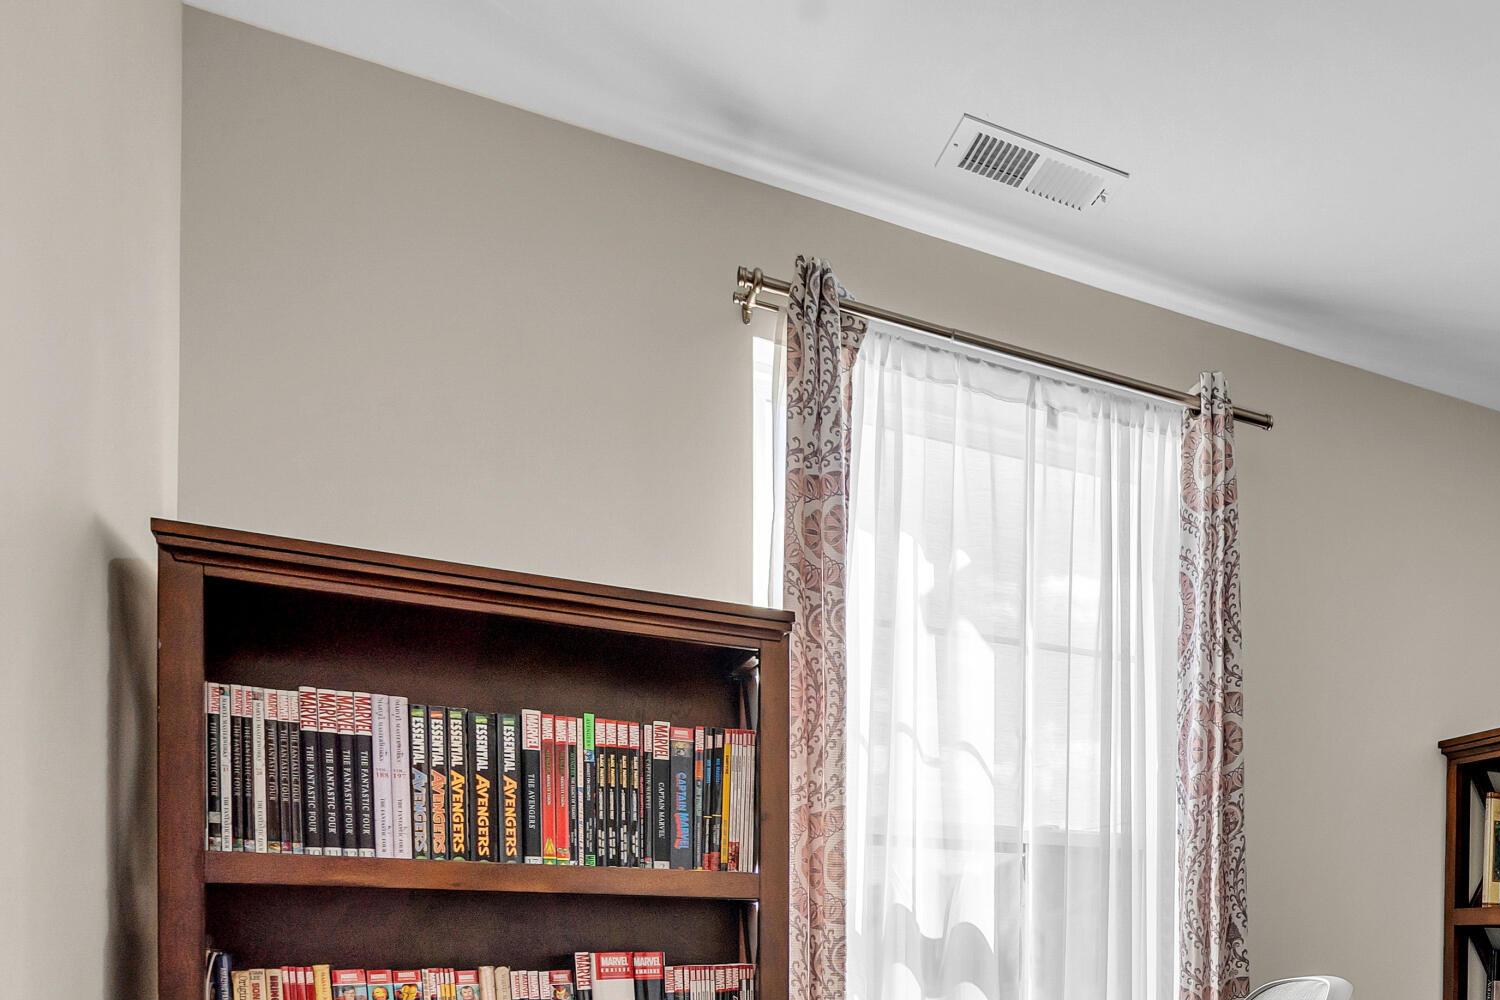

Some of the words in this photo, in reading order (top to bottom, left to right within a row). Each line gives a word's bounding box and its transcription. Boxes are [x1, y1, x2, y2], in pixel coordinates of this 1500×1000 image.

[301, 692, 315, 728] MARVEL
[319, 693, 335, 730] MARVEL
[337, 695, 353, 732] MARVEL
[355, 696, 371, 733] MARVEL
[412, 716, 424, 765] ESSENTIAL
[432, 719, 443, 767] ESSENTIAL
[451, 719, 462, 767] ESSENTIAL
[476, 724, 488, 771] ESSENTIAL
[504, 726, 515, 772] ESSENTIAL
[527, 715, 538, 748] MARVEL
[655, 725, 667, 758] MARVEL
[305, 746, 315, 761] THE
[324, 748, 335, 763] THE
[342, 750, 352, 765] THE
[360, 751, 369, 766] THE
[306, 764, 317, 808] FANTASTIC
[325, 766, 336, 809] FANTASTIC
[343, 768, 353, 811] FANTASTIC
[361, 769, 371, 811] FANTASTIC
[527, 774, 536, 788] THE
[676, 772, 687, 811] CAPTAIN
[308, 811, 318, 832] FOUR
[327, 812, 337, 833] FOUR
[344, 813, 354, 833] FOUR
[362, 814, 372, 834] FOUR
[412, 767, 427, 852] AVENGERS
[431, 769, 446, 853] AVENGERS
[450, 770, 465, 852] AVENGERS
[475, 774, 490, 856] AVENGERS
[503, 775, 517, 856] AVENGERS
[527, 790, 536, 829] AVENGERS
[658, 812, 666, 837] MARVEL
[674, 813, 689, 849] MARVEL
[576, 954, 590, 989] MARVEL
[601, 956, 628, 966] MARVEL
[634, 956, 660, 966] MARVEL
[251, 983, 261, 999] SON
